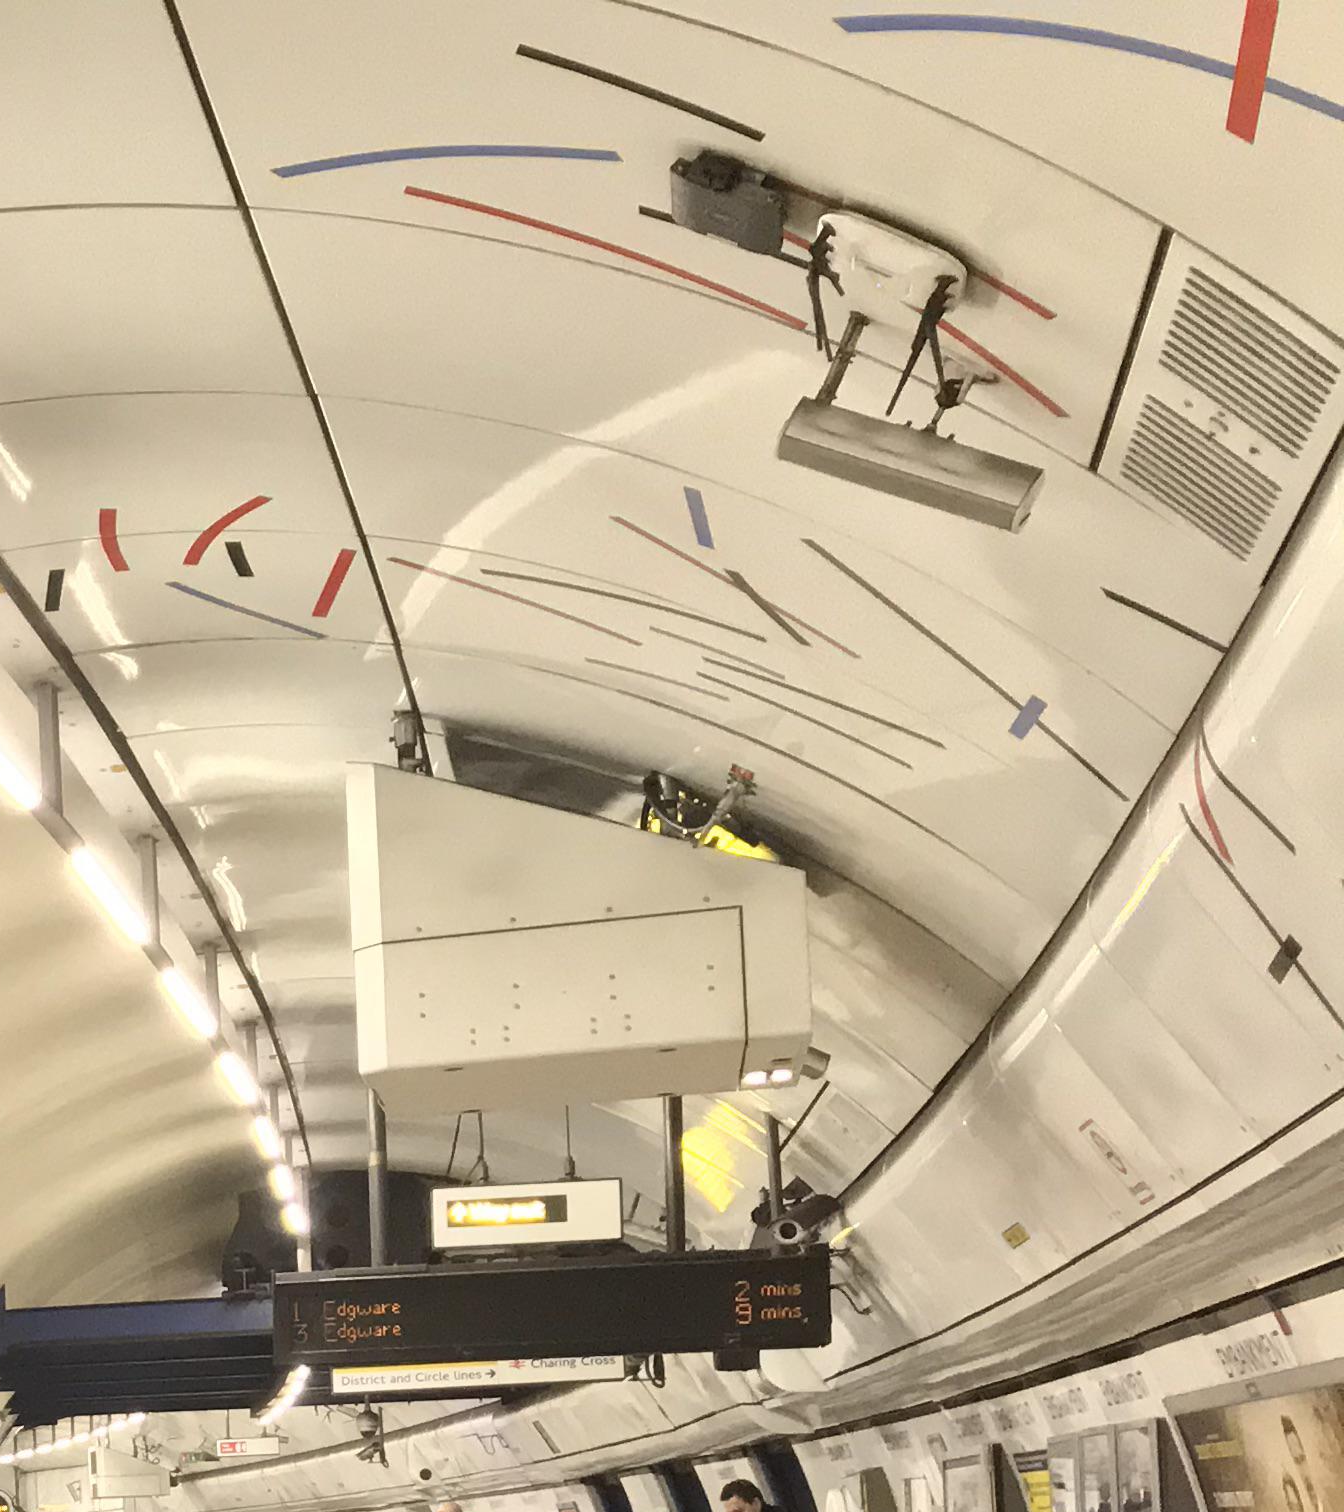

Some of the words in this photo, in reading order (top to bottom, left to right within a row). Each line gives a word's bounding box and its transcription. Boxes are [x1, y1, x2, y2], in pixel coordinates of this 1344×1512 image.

[293, 1301, 300, 1321] 1
[323, 1300, 401, 1321] Edgware
[735, 1280, 750, 1302] 2
[761, 1283, 802, 1296] mins
[323, 1322, 402, 1343] Edgware
[761, 1305, 802, 1320] mins
[530, 1356, 577, 1369] Charing
[580, 1355, 616, 1367] Cross
[341, 1374, 385, 1386] District
[390, 1372, 411, 1384] and
[415, 1371, 450, 1383] Circle
[454, 1369, 482, 1381] lines
